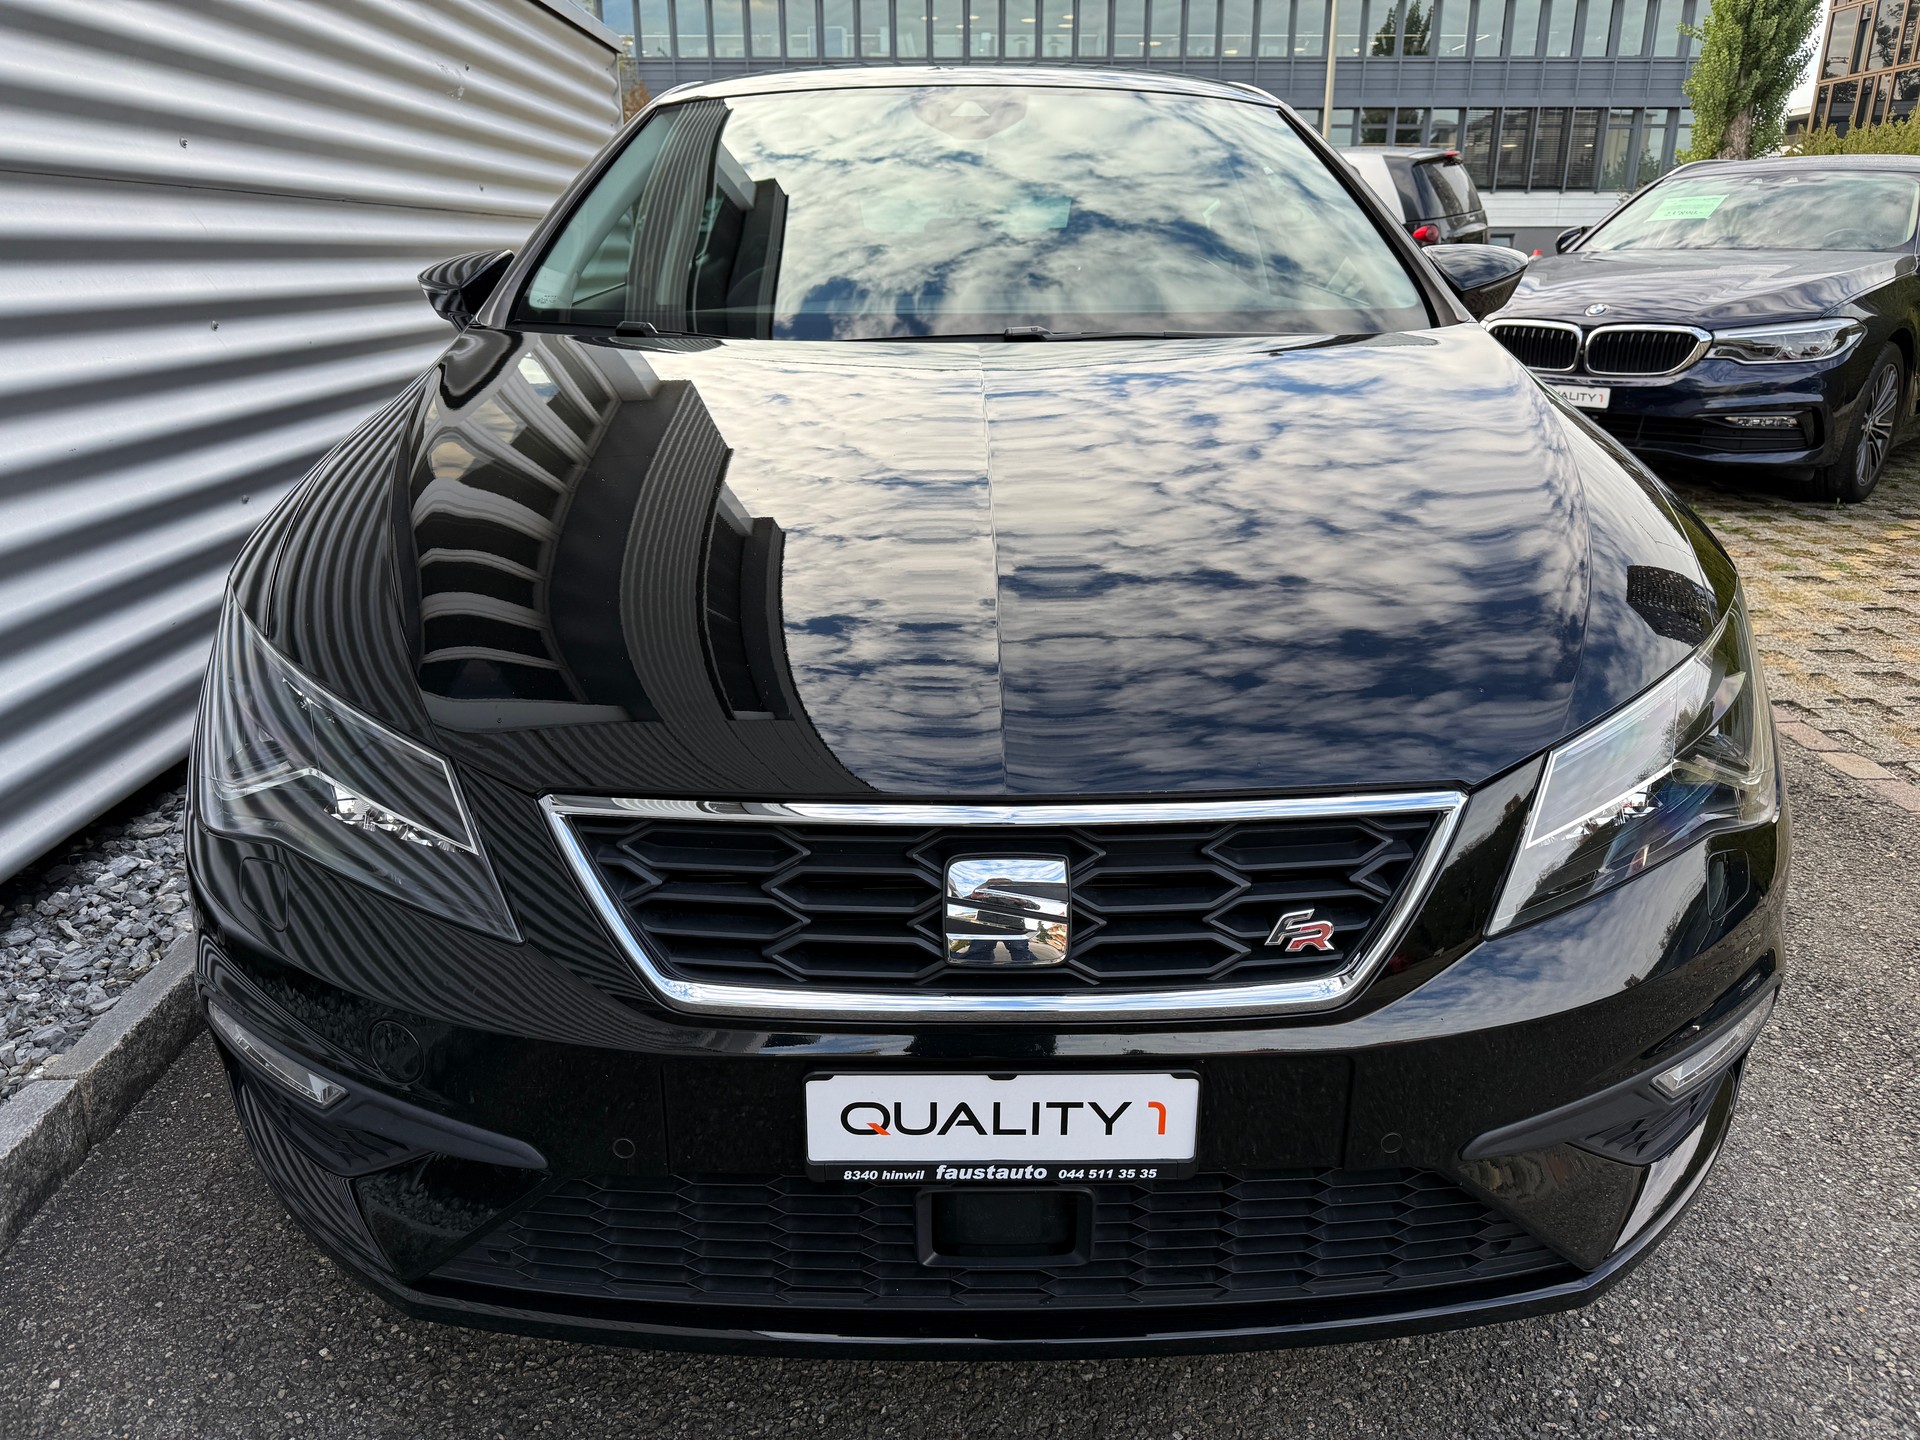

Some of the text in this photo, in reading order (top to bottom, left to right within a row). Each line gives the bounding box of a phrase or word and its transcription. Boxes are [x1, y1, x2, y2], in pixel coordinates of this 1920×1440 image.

[1559, 391, 1604, 403] ALITY 1
[1264, 908, 1335, 952] FR
[839, 1101, 1166, 1136] QUALITY 1
[843, 1165, 1157, 1180] 8340 hinwil faustauto 044 511 35 35
